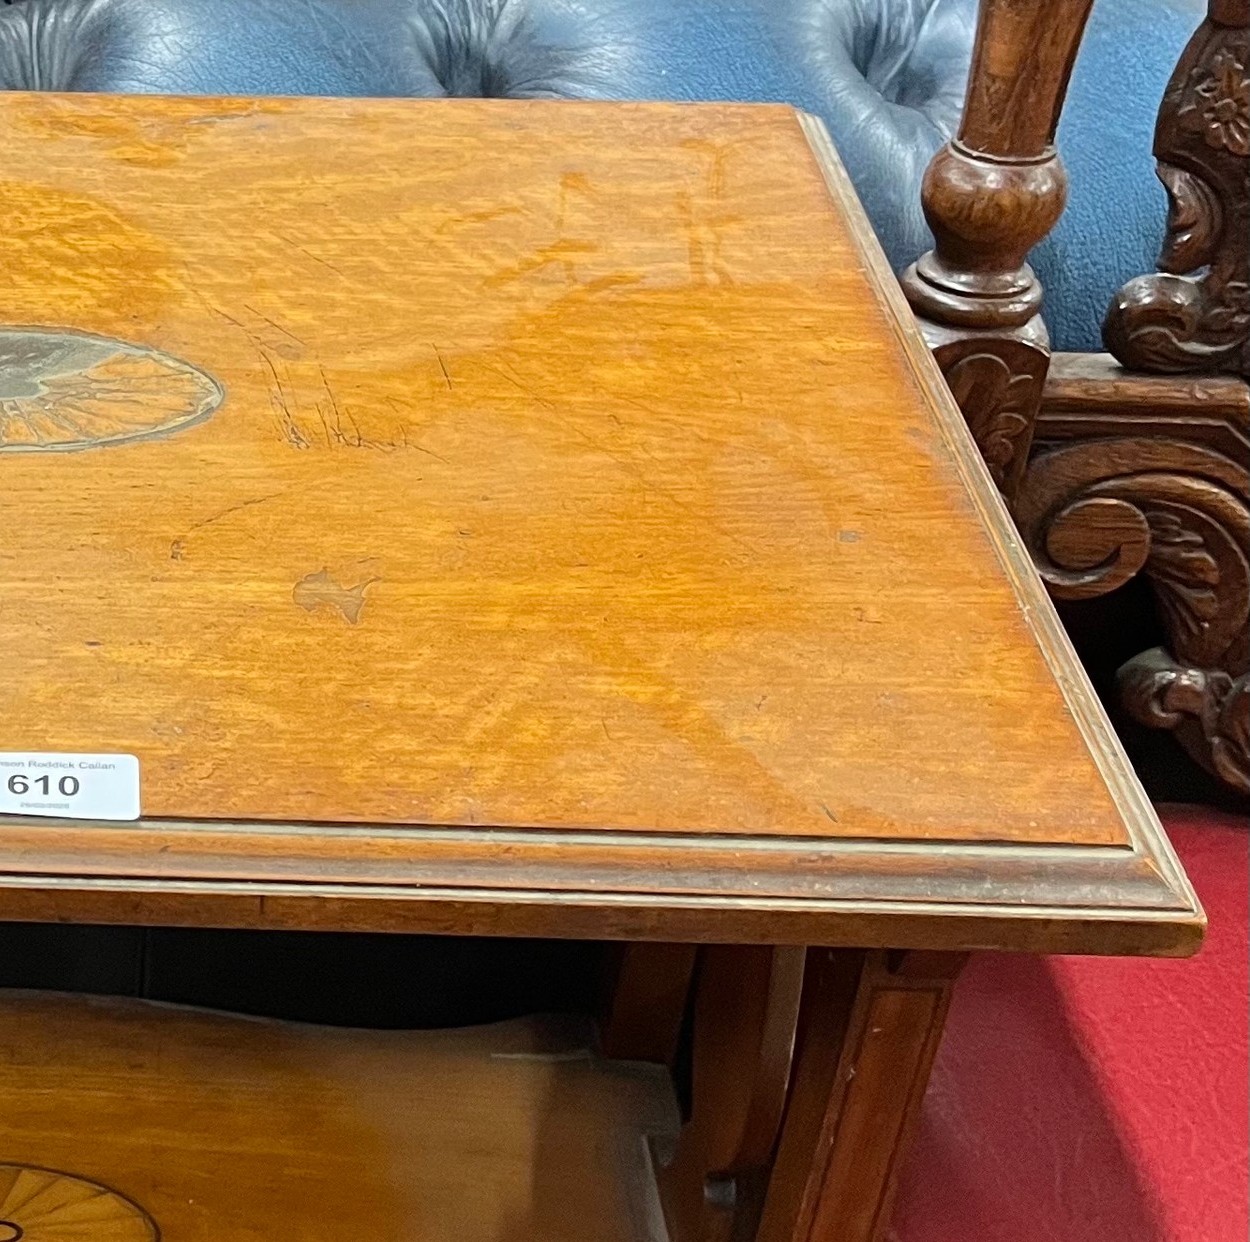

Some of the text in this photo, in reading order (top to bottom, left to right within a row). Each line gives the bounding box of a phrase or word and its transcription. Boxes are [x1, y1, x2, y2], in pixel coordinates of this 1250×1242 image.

[28, 760, 75, 770] Roddick
[78, 762, 116, 770] Callan
[7, 774, 80, 796] 610
